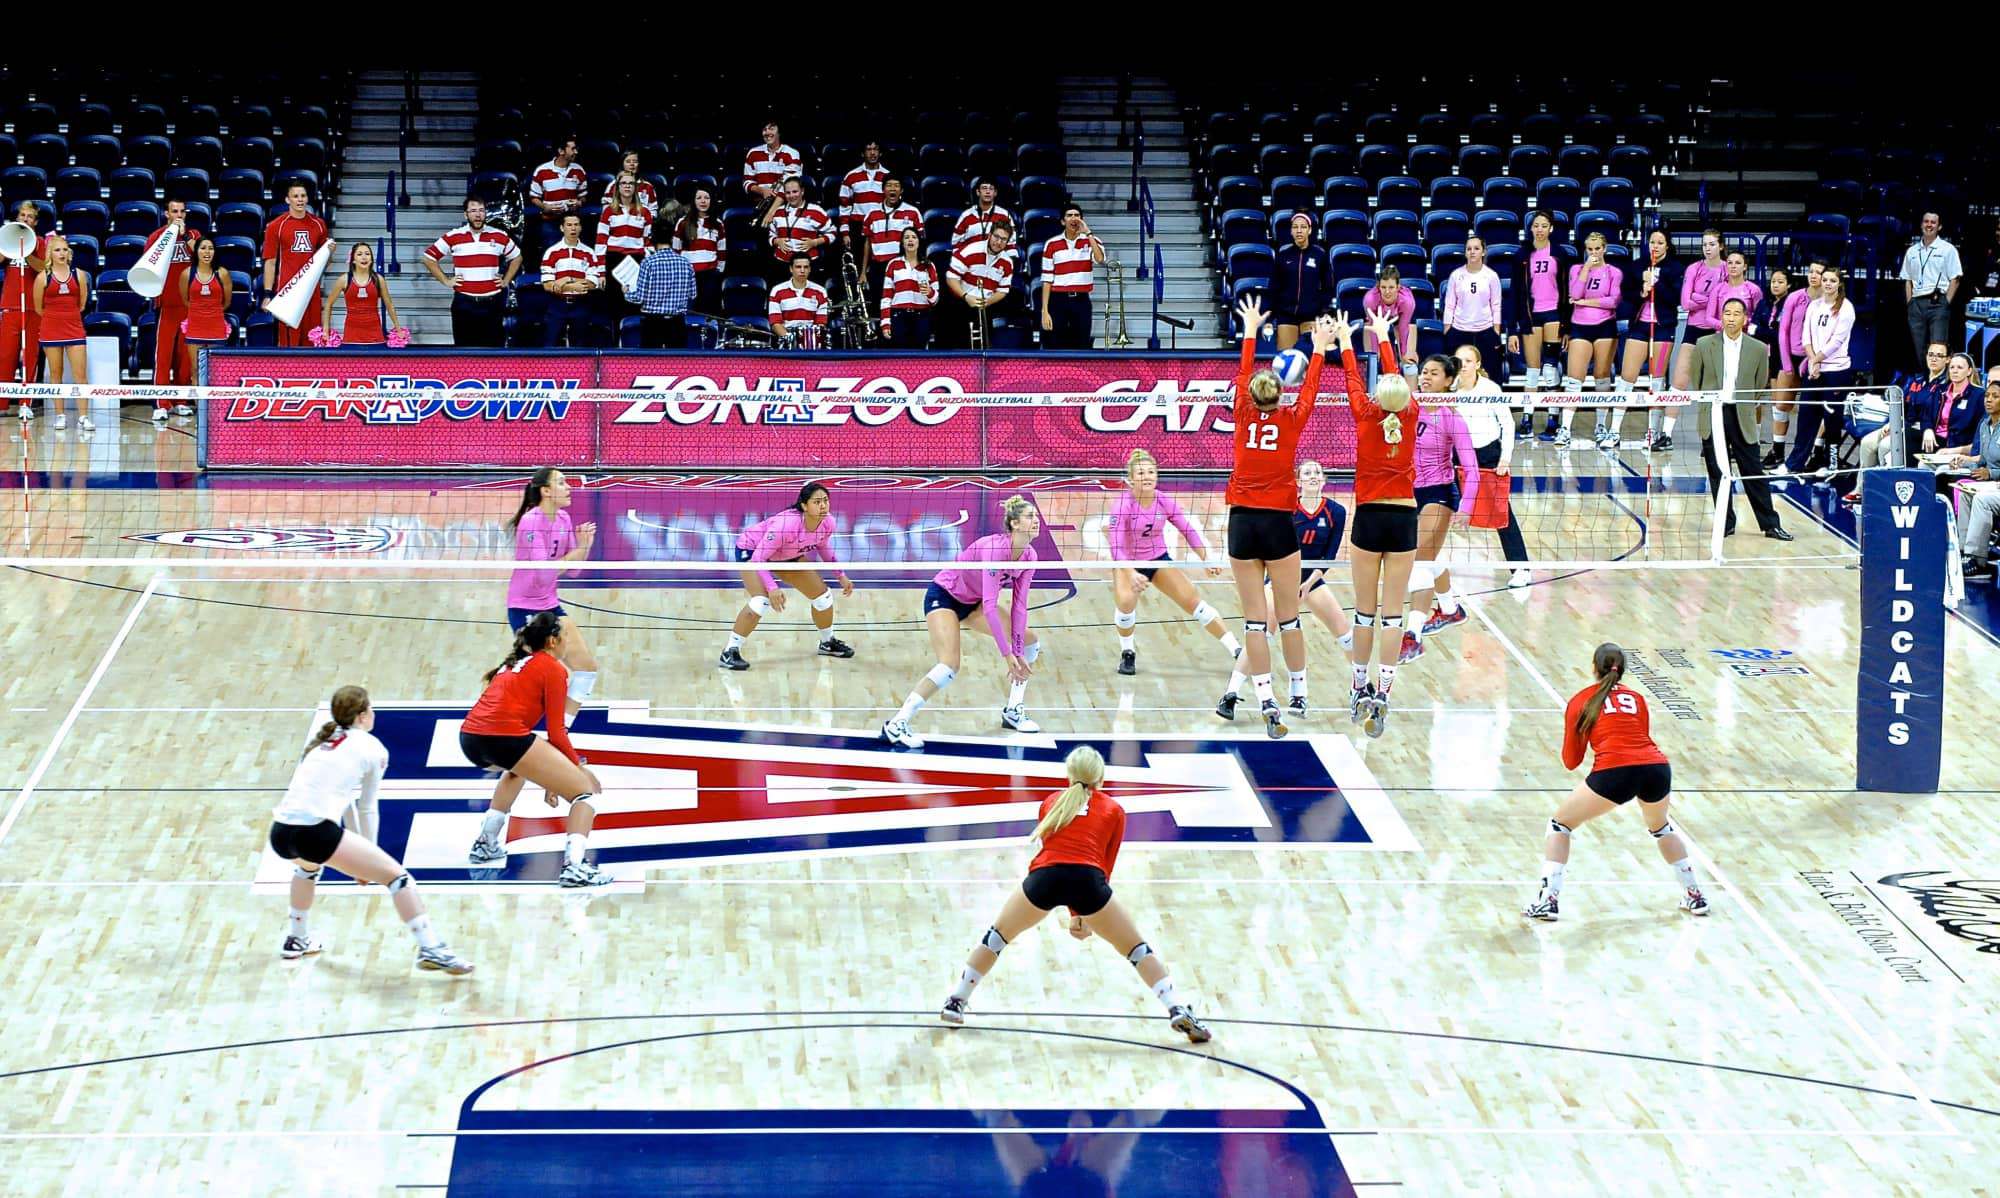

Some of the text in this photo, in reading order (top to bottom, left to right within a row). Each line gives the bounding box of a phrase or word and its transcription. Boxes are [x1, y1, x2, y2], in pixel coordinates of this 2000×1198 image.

[1534, 261, 1549, 273] 33
[1470, 282, 1478, 294] 5
[1586, 279, 1601, 290] 15
[1703, 280, 1712, 292] 7
[1817, 315, 1830, 327] 13
[0, 386, 62, 395] VOLLEYBALL
[1245, 423, 1278, 451] 12
[1142, 524, 1153, 537] 2
[1303, 530, 1316, 545] 11
[1887, 505, 1920, 746] WILDCATS
[1604, 693, 1638, 714] 19
[1799, 871, 1834, 888] Lute
[1856, 928, 1899, 955] Olson
[1884, 956, 1931, 984] Court
